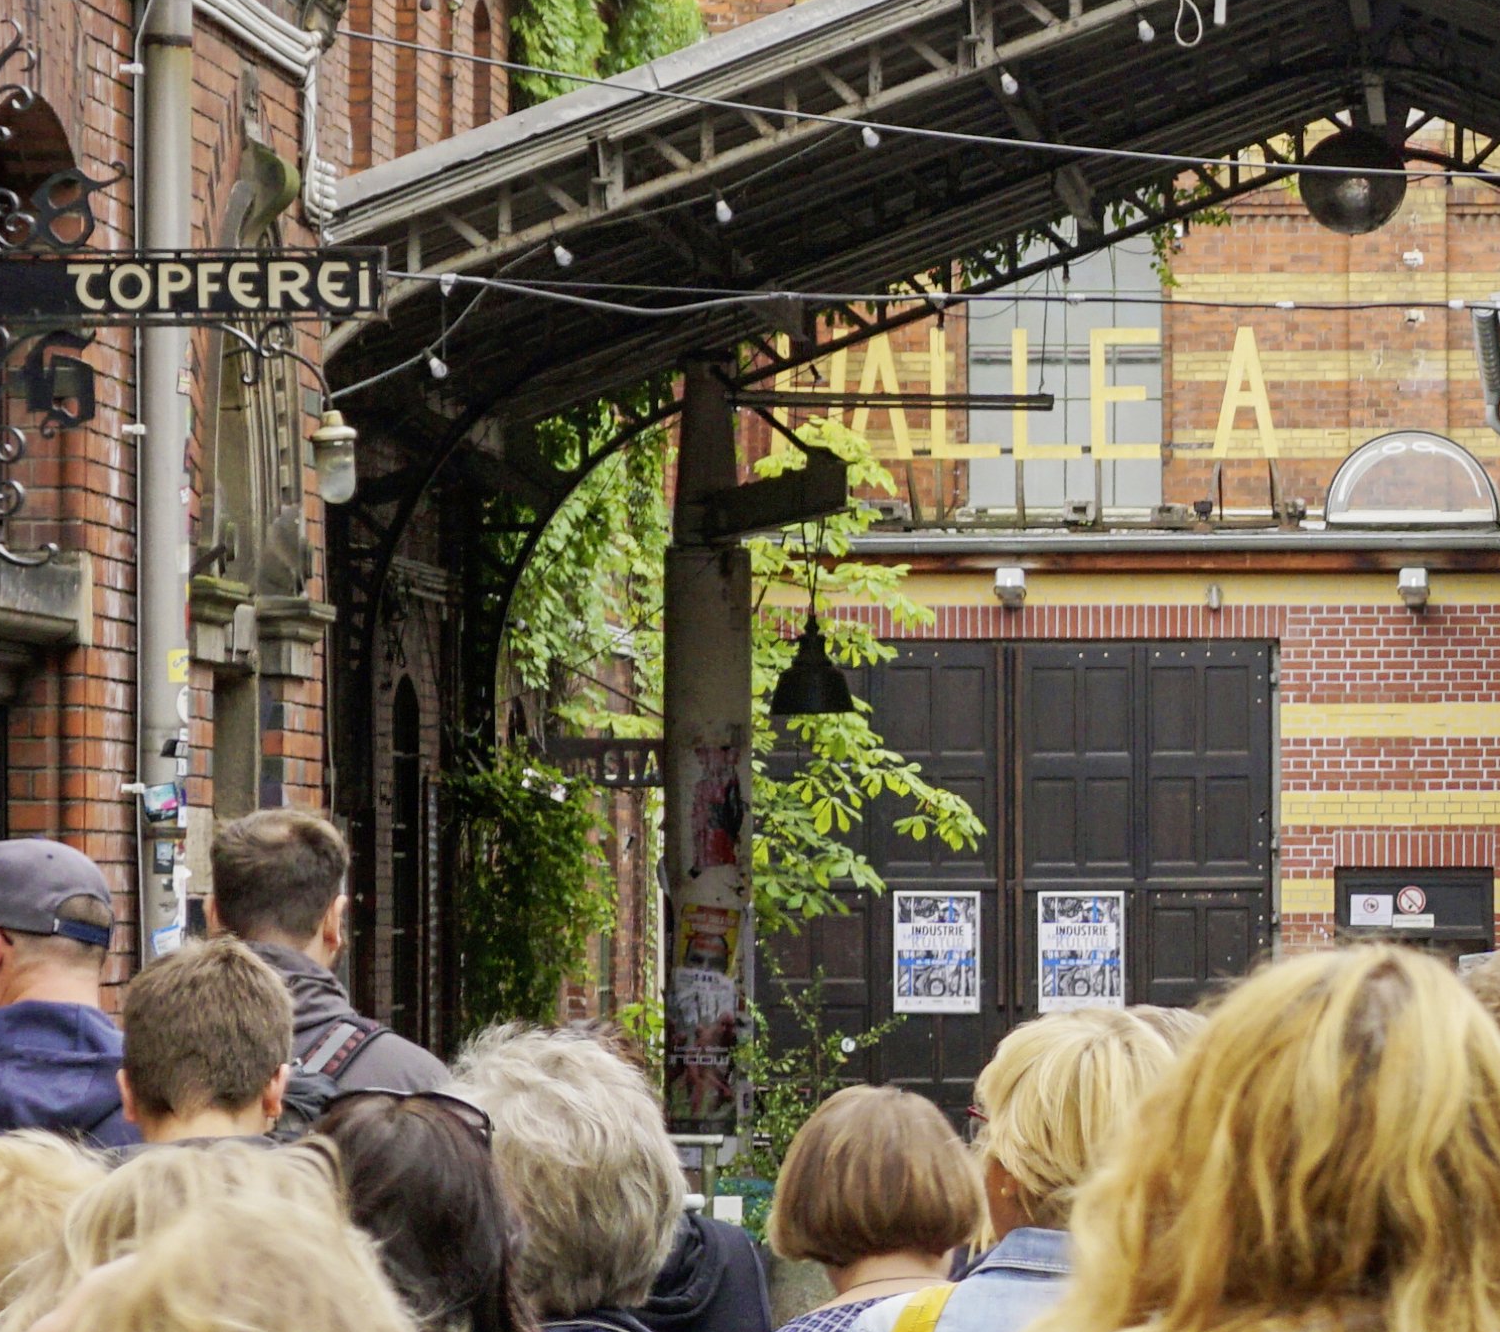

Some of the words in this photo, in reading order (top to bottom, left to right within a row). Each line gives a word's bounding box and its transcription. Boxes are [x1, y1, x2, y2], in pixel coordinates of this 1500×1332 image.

[770, 327, 1161, 460] HALLE
[1211, 325, 1279, 460] A
[911, 925, 964, 936] INDUSTRIE
[1055, 925, 1108, 936] INDUSTRIE
